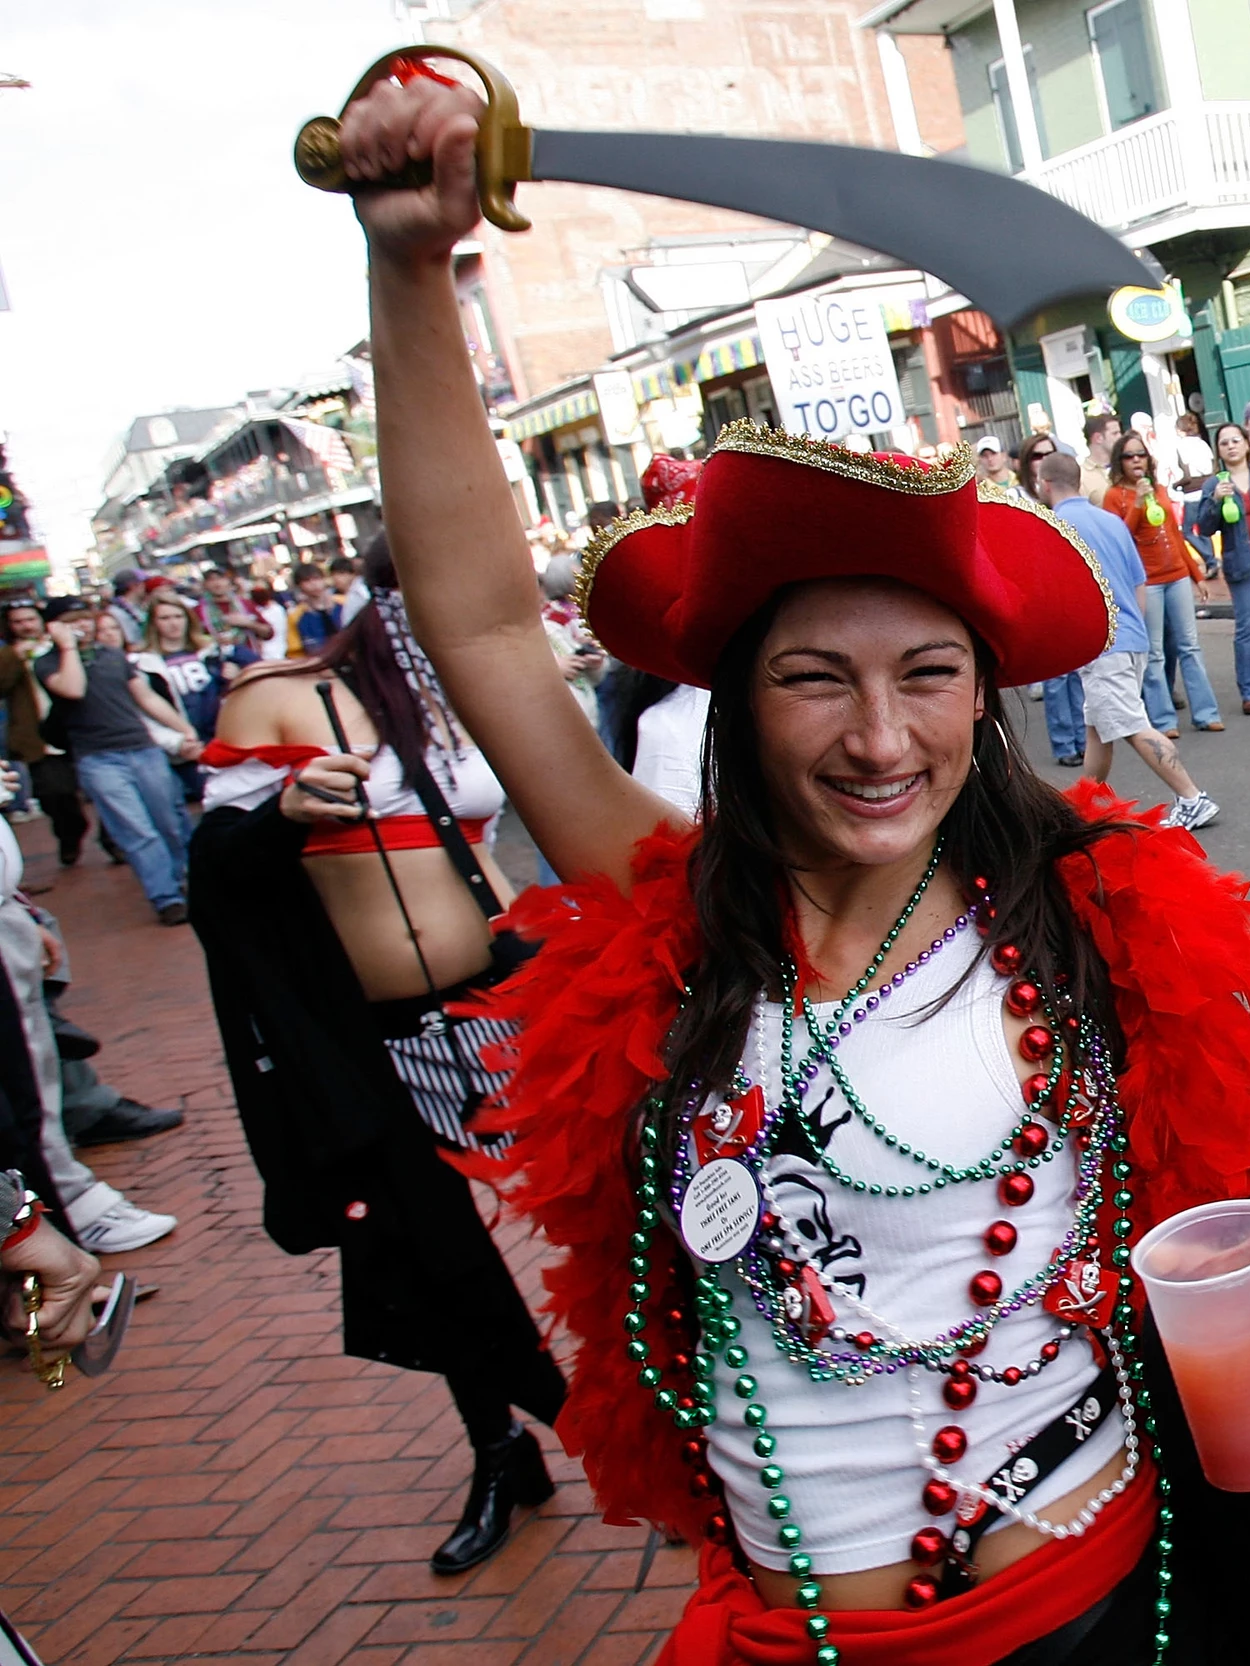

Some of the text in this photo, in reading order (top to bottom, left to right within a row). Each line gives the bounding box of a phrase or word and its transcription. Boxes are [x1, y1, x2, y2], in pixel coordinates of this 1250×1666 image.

[777, 303, 873, 350] HUGE
[790, 355, 884, 390] ASS BEERS
[168, 661, 212, 695] 18
[700, 1211, 717, 1228] THREE
[715, 1203, 728, 1217] FREE
[706, 1195, 720, 1211] Good
[700, 1241, 712, 1254] ONE
[711, 1231, 723, 1246] FREE
[723, 1223, 734, 1235] SPA
